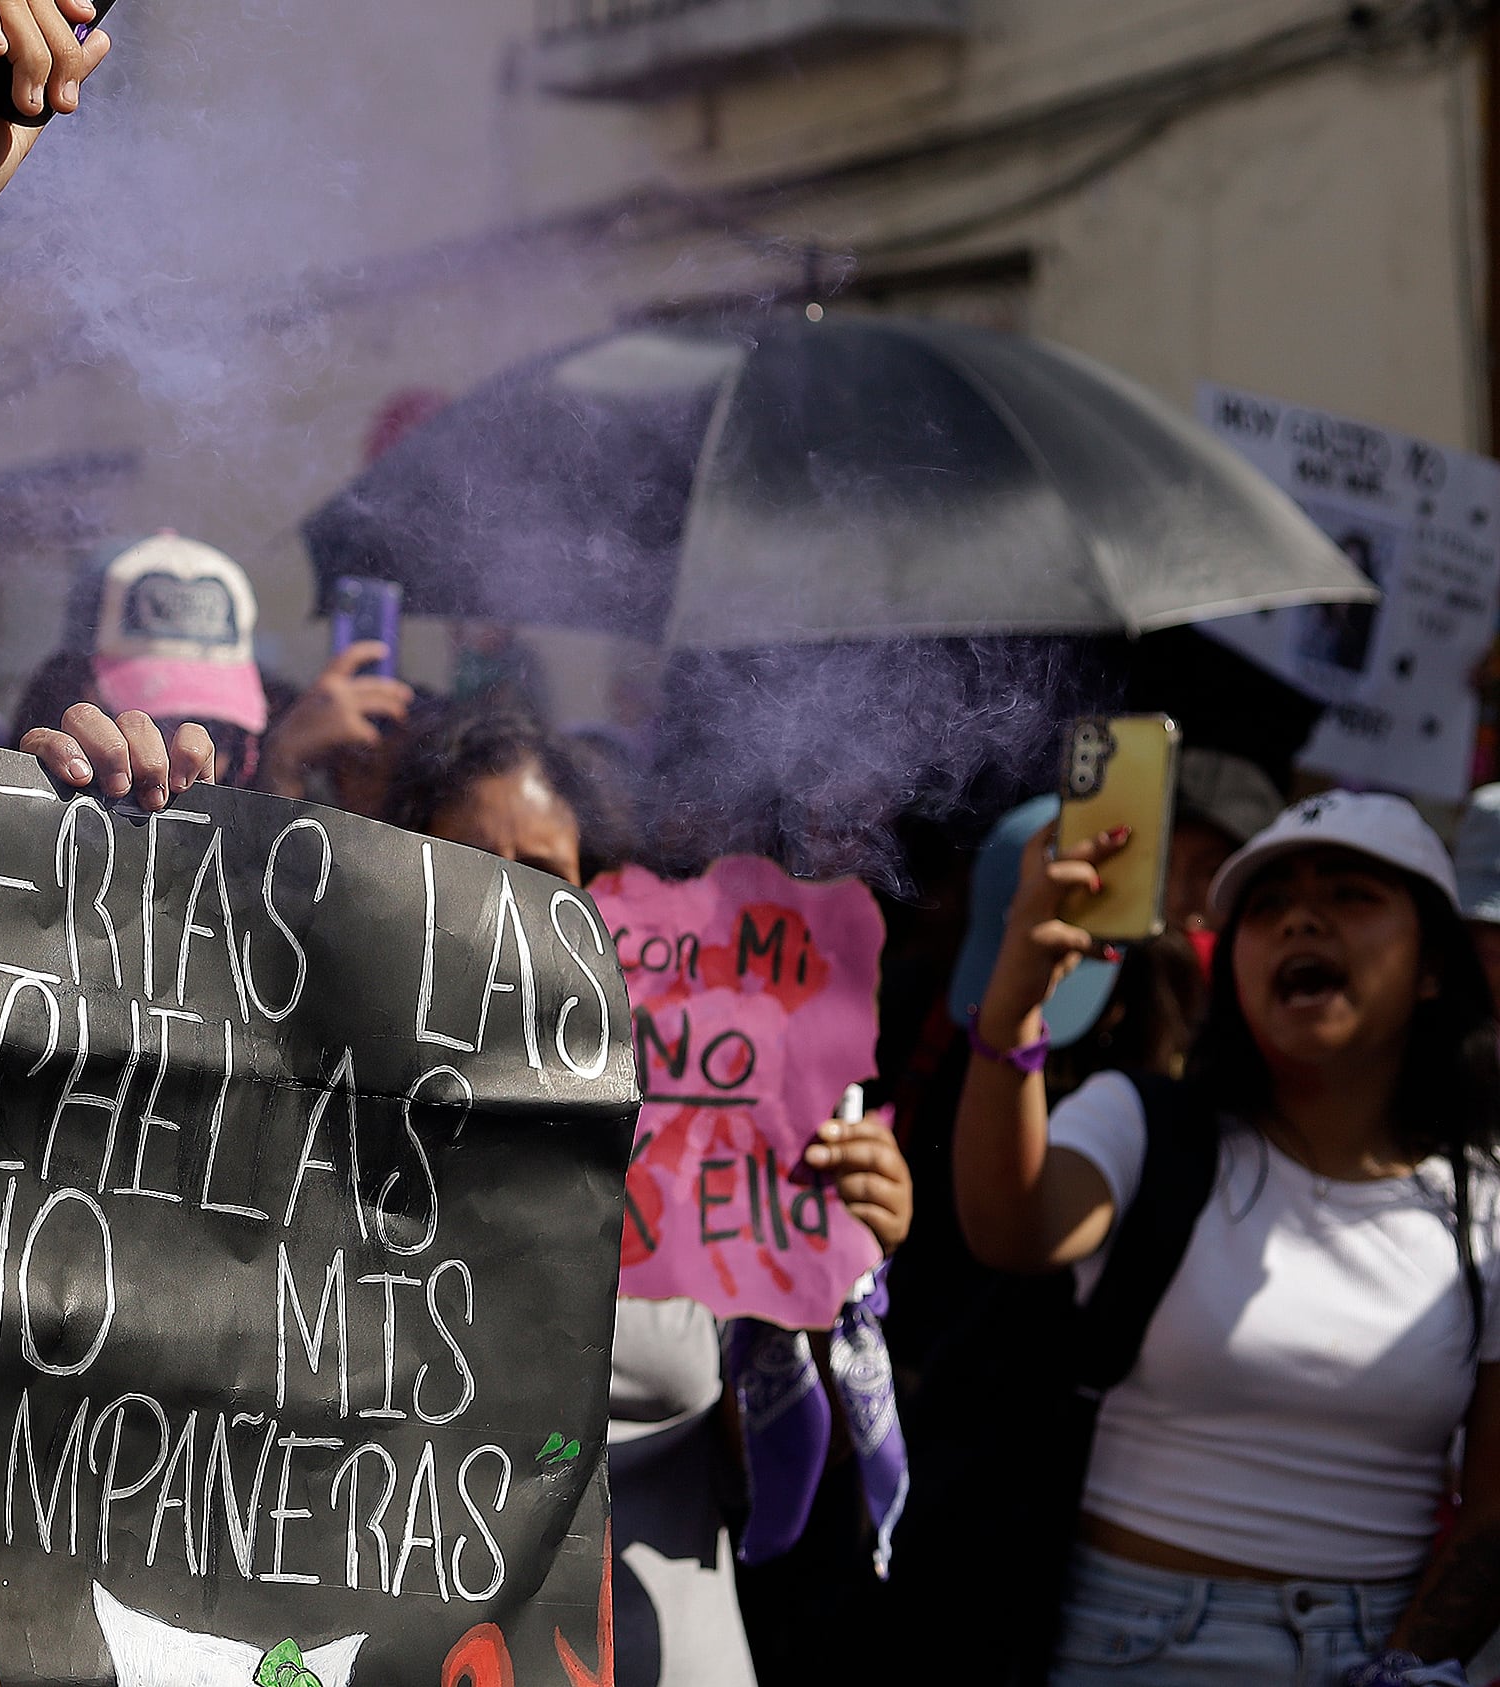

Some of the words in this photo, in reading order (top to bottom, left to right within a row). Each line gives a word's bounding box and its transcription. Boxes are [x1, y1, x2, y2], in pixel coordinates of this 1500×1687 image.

[416, 841, 613, 1081] LAS
[613, 924, 699, 980] con
[735, 911, 811, 986] Mi
[634, 1004, 756, 1092] NO
[699, 1148, 830, 1252] Ella
[275, 1241, 475, 1425] MIS
